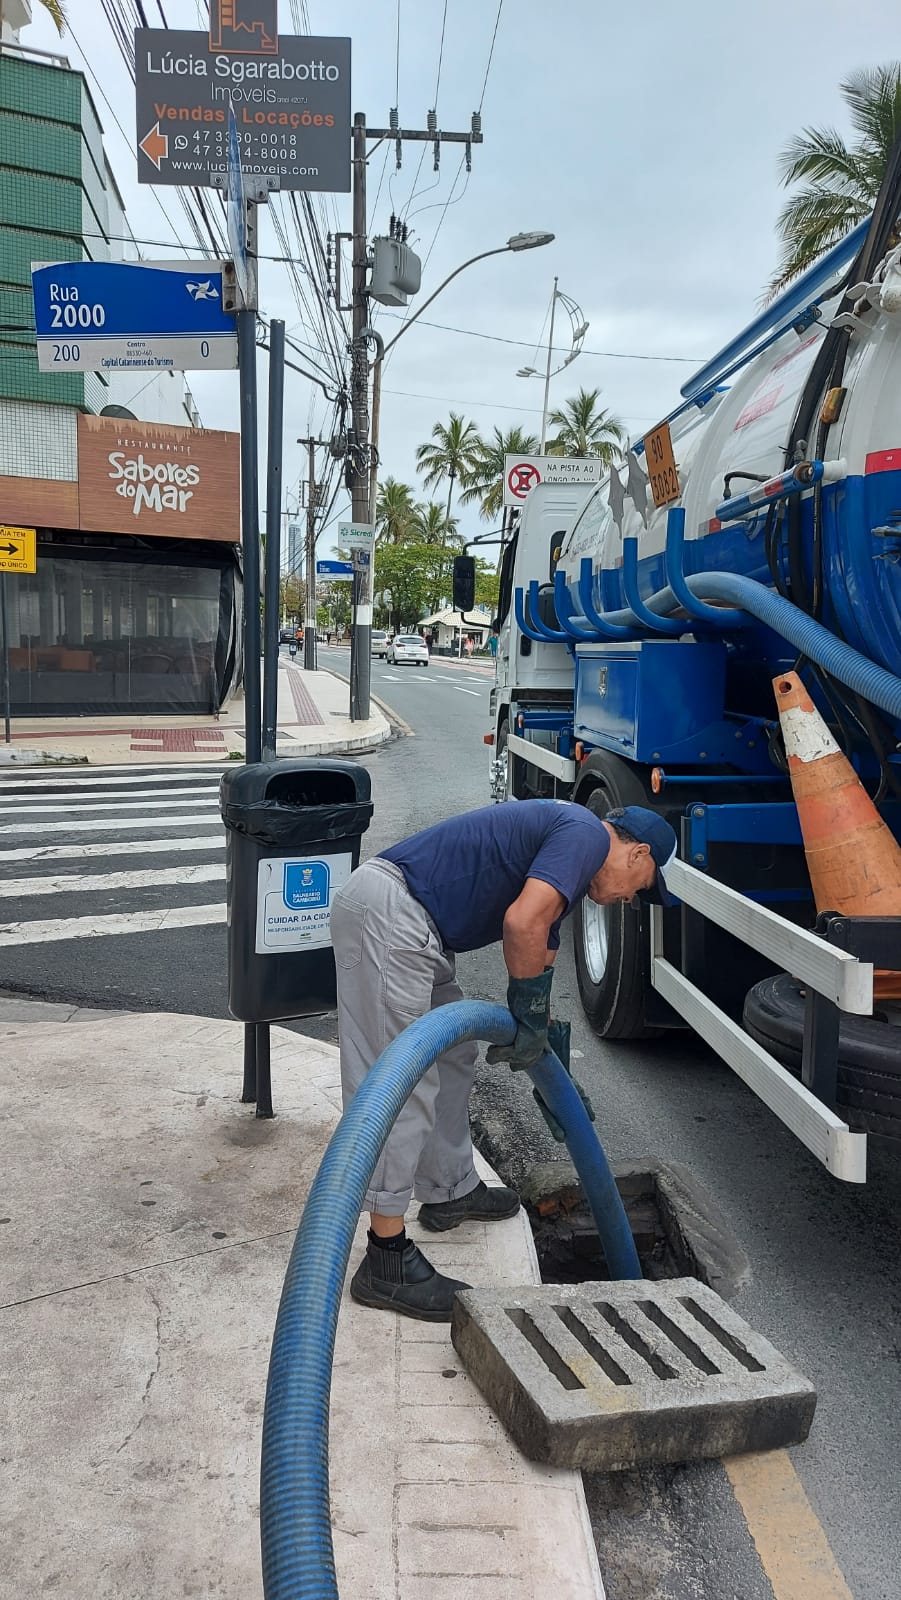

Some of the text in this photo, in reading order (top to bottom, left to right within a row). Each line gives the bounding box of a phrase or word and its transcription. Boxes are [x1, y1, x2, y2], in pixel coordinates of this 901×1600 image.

[147, 51, 340, 82] Lúcia Sgarabotto
[211, 81, 277, 103] Imóveis
[154, 103, 335, 129] Vendas Locações
[192, 130, 210, 142] 47
[192, 145, 297, 160] 47 354-8008
[50, 283, 79, 302] Rua
[50, 304, 106, 328] 2000
[53, 340, 210, 362] 200 0
[101, 357, 174, 368] Capital Catarinense do Turismo
[117, 438, 191, 454] RESTAURANTE
[651, 434, 664, 464] 90
[108, 451, 200, 487] Sabores
[547, 463, 594, 473] NA PISTA AO
[652, 466, 677, 501] 3082
[115, 479, 193, 515] do Mar
[8, 560, 28, 569] ÚNICO
[267, 915, 299, 924] CUIDAR
[301, 914, 312, 922] DA
